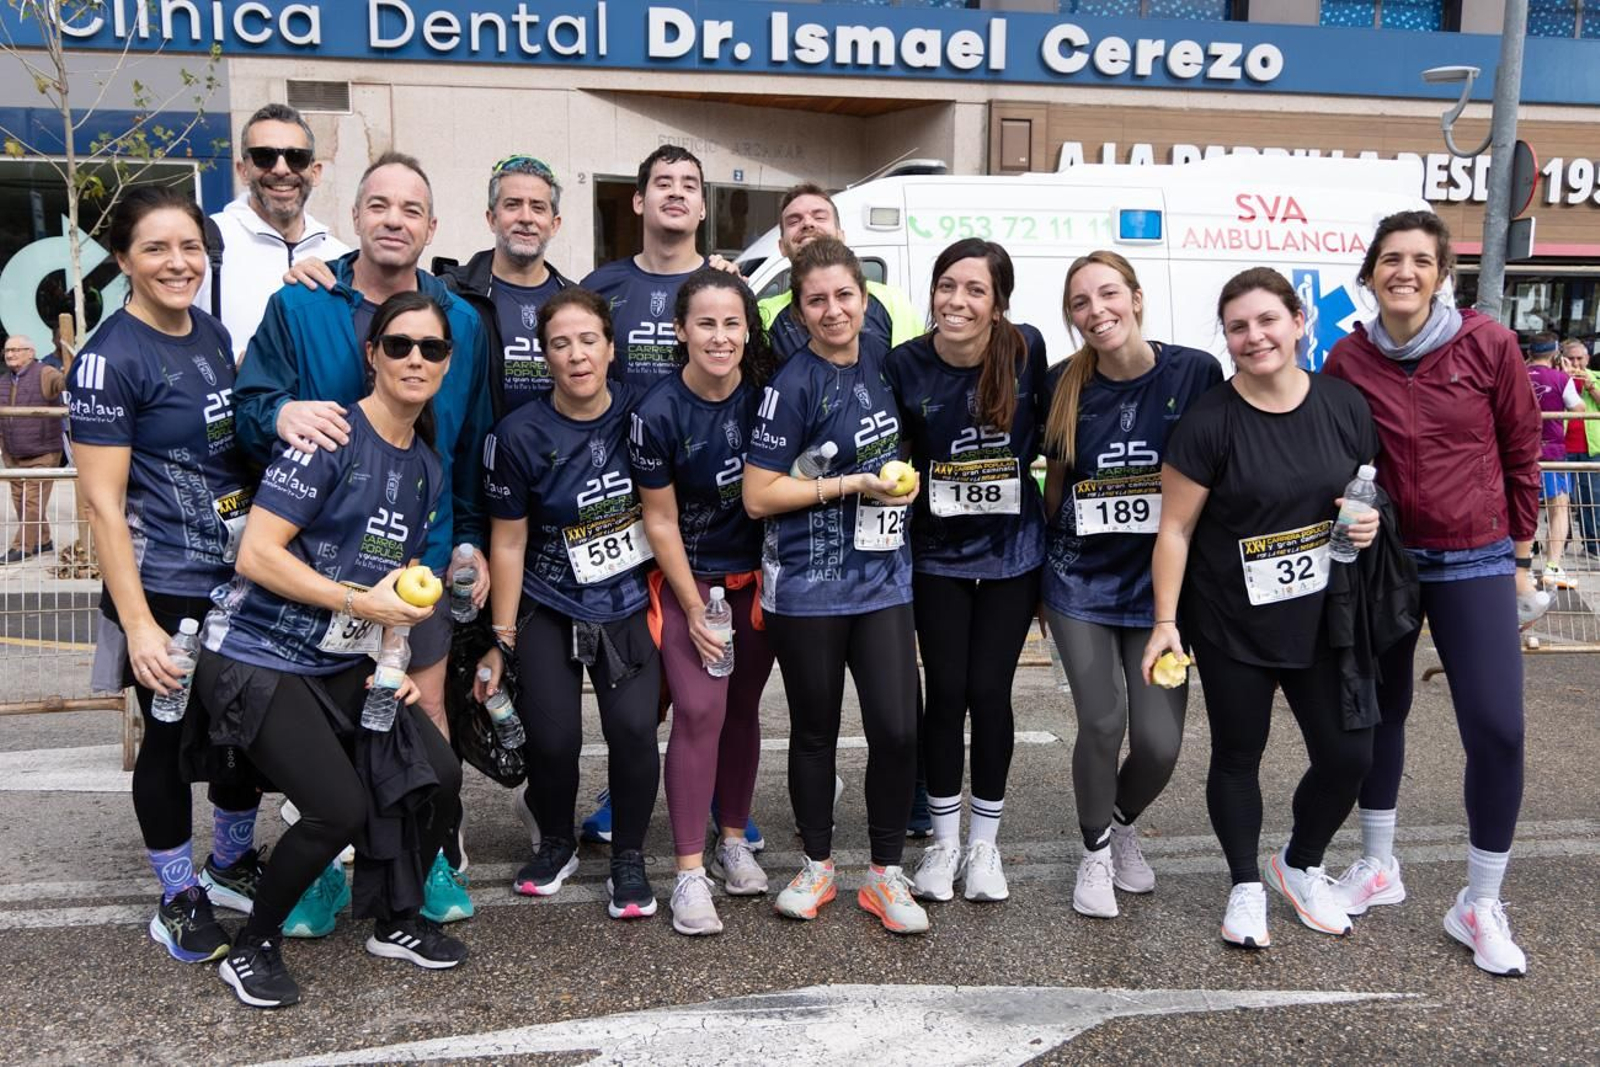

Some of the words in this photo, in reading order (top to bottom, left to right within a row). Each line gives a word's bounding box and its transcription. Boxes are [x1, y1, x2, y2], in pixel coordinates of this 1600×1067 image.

[369, 0, 607, 56] Dental
[648, 6, 752, 61] Dr.
[770, 12, 1007, 71] Ismael
[1041, 23, 1284, 83] Cerezo
[577, 173, 586, 184] 2
[1235, 193, 1308, 225] SVA
[938, 215, 993, 239] 953
[1002, 216, 1039, 240] 72
[1050, 217, 1073, 240] 11
[1182, 227, 1366, 253] AMBULANCIA
[628, 321, 679, 346] 25
[854, 410, 899, 449] 25
[951, 426, 1011, 455] 25
[168, 447, 191, 461] IES
[1097, 441, 1159, 468] 25
[934, 464, 953, 474] XXV
[577, 471, 633, 508] 25
[949, 484, 1001, 502] 188
[1077, 482, 1097, 493] XXV
[366, 507, 409, 542] 25
[1096, 498, 1149, 525] 189
[566, 525, 587, 541] XXV
[317, 541, 339, 559] IES
[588, 531, 635, 567] 581
[1244, 540, 1266, 554] XXV
[1276, 556, 1315, 585] 32
